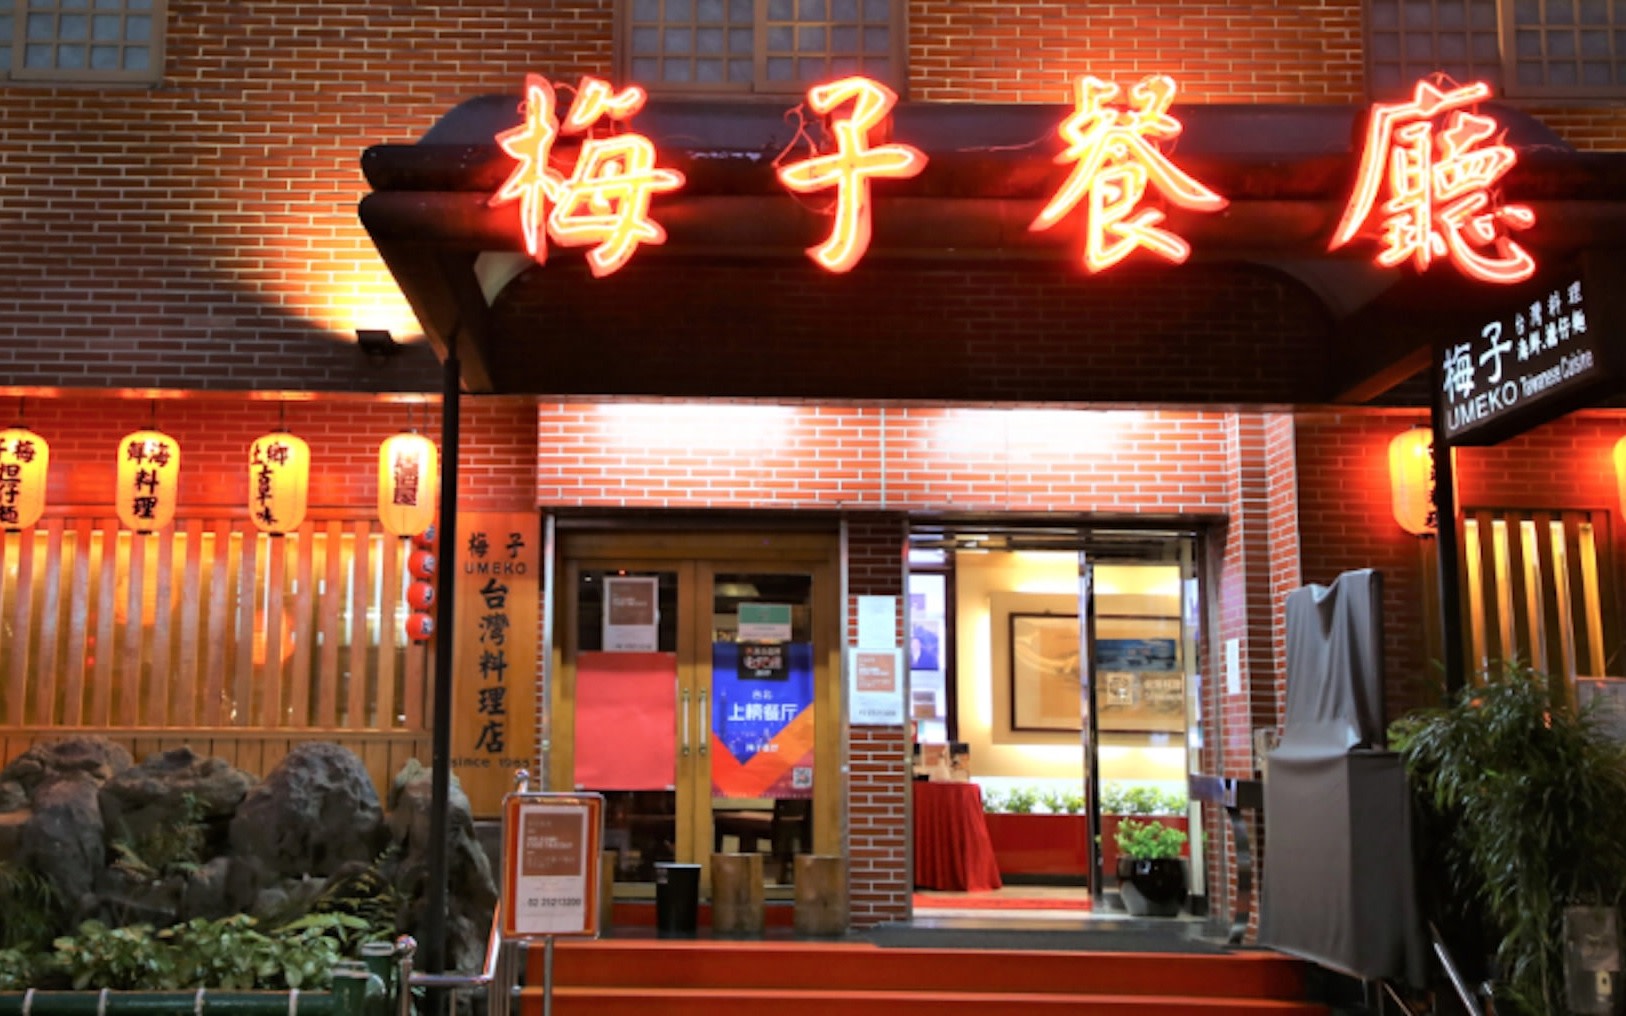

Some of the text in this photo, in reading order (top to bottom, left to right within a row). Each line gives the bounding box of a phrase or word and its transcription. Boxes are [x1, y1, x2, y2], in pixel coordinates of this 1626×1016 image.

[488, 73, 1537, 284] 梅子餐廳
[1443, 321, 1513, 404] 梅子
[1446, 381, 1518, 430] UMEKO
[1561, 349, 1594, 379] Cuisine
[464, 562, 527, 575] UMEKO
[468, 532, 525, 558] 梅子
[475, 578, 510, 753] 台灣料理店
